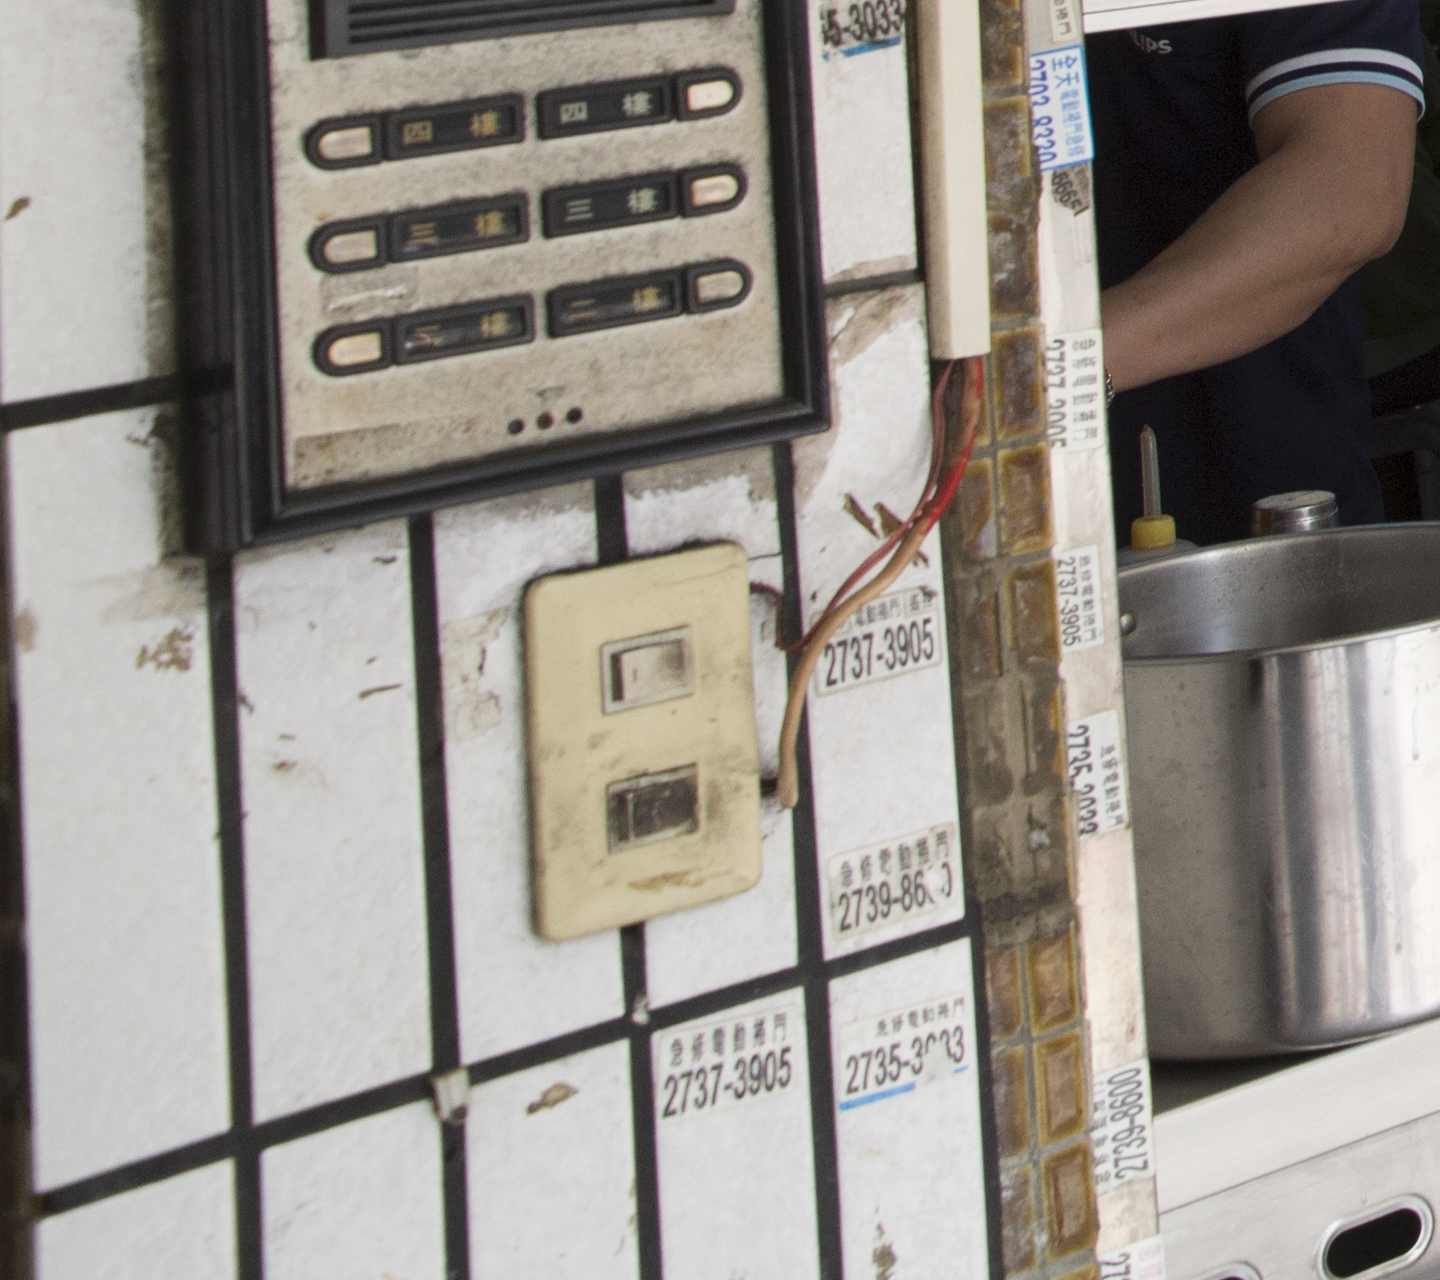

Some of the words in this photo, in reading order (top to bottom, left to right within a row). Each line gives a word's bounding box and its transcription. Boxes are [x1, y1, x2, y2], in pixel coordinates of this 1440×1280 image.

[558, 90, 653, 123] 四樓
[564, 186, 658, 223] 三樓
[1057, 557, 1081, 646] 2737-3905
[823, 616, 935, 688] 2737-3905
[661, 1046, 792, 1119] 2737-3905
[1107, 1068, 1148, 1179] 2739-8600
